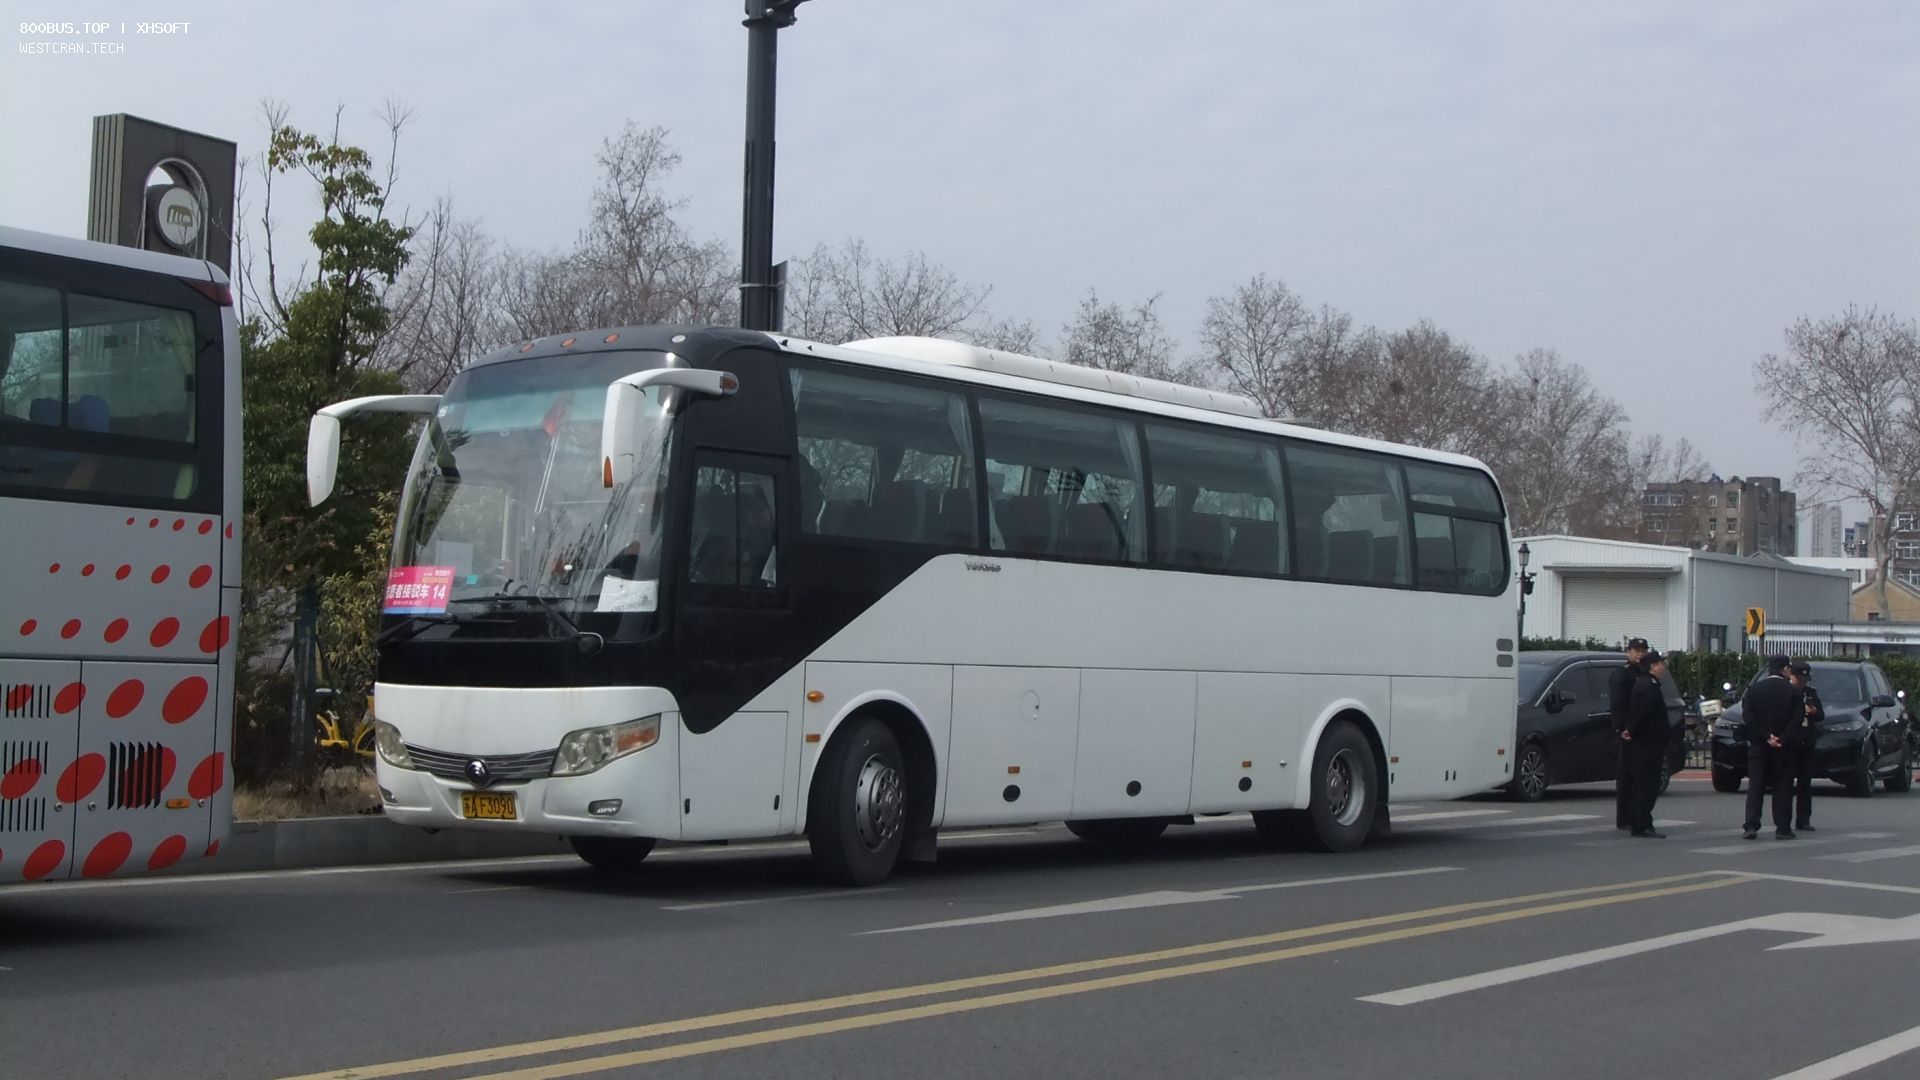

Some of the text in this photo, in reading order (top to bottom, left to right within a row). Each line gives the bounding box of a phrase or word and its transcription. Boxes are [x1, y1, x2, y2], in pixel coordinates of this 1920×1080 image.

[385, 583, 447, 600] 愿者接驳车 14
